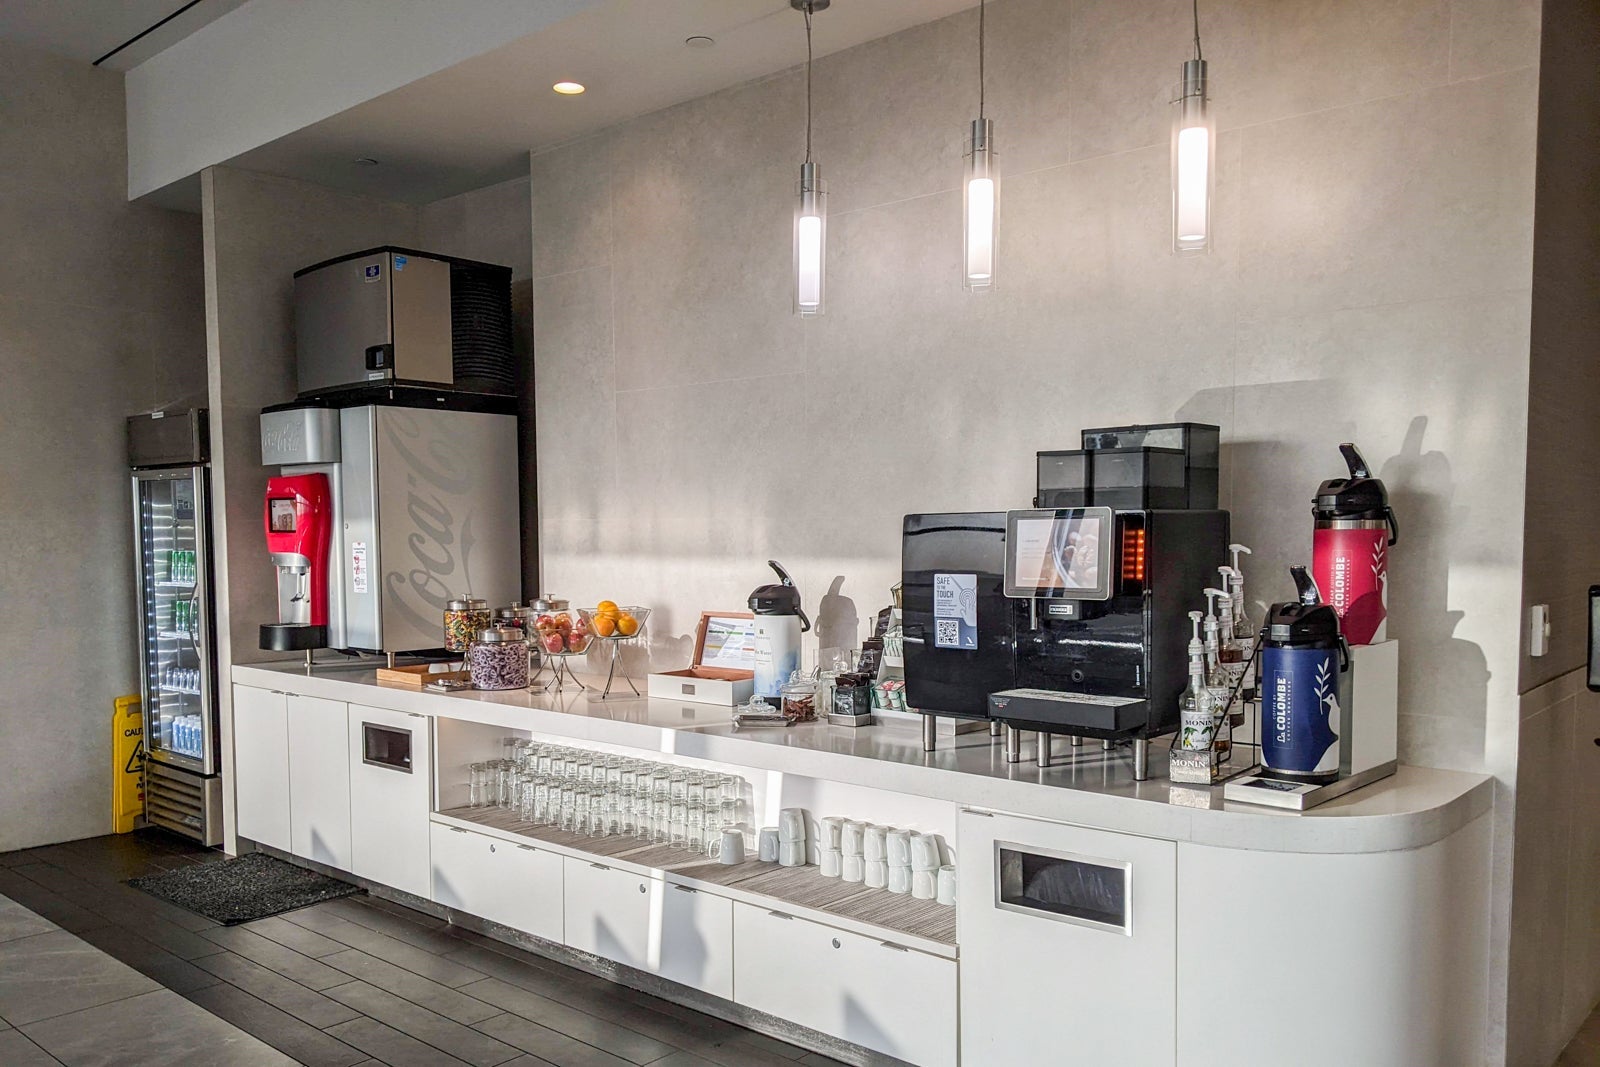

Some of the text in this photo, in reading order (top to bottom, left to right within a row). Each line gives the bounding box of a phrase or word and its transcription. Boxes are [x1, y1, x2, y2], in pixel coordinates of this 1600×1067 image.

[1335, 557, 1345, 607] COLOMBE
[937, 590, 953, 598] TOUCH
[1276, 678, 1286, 743] La COLOMBE
[124, 727, 144, 737] CAUT
[1171, 759, 1206, 768] MONIN
